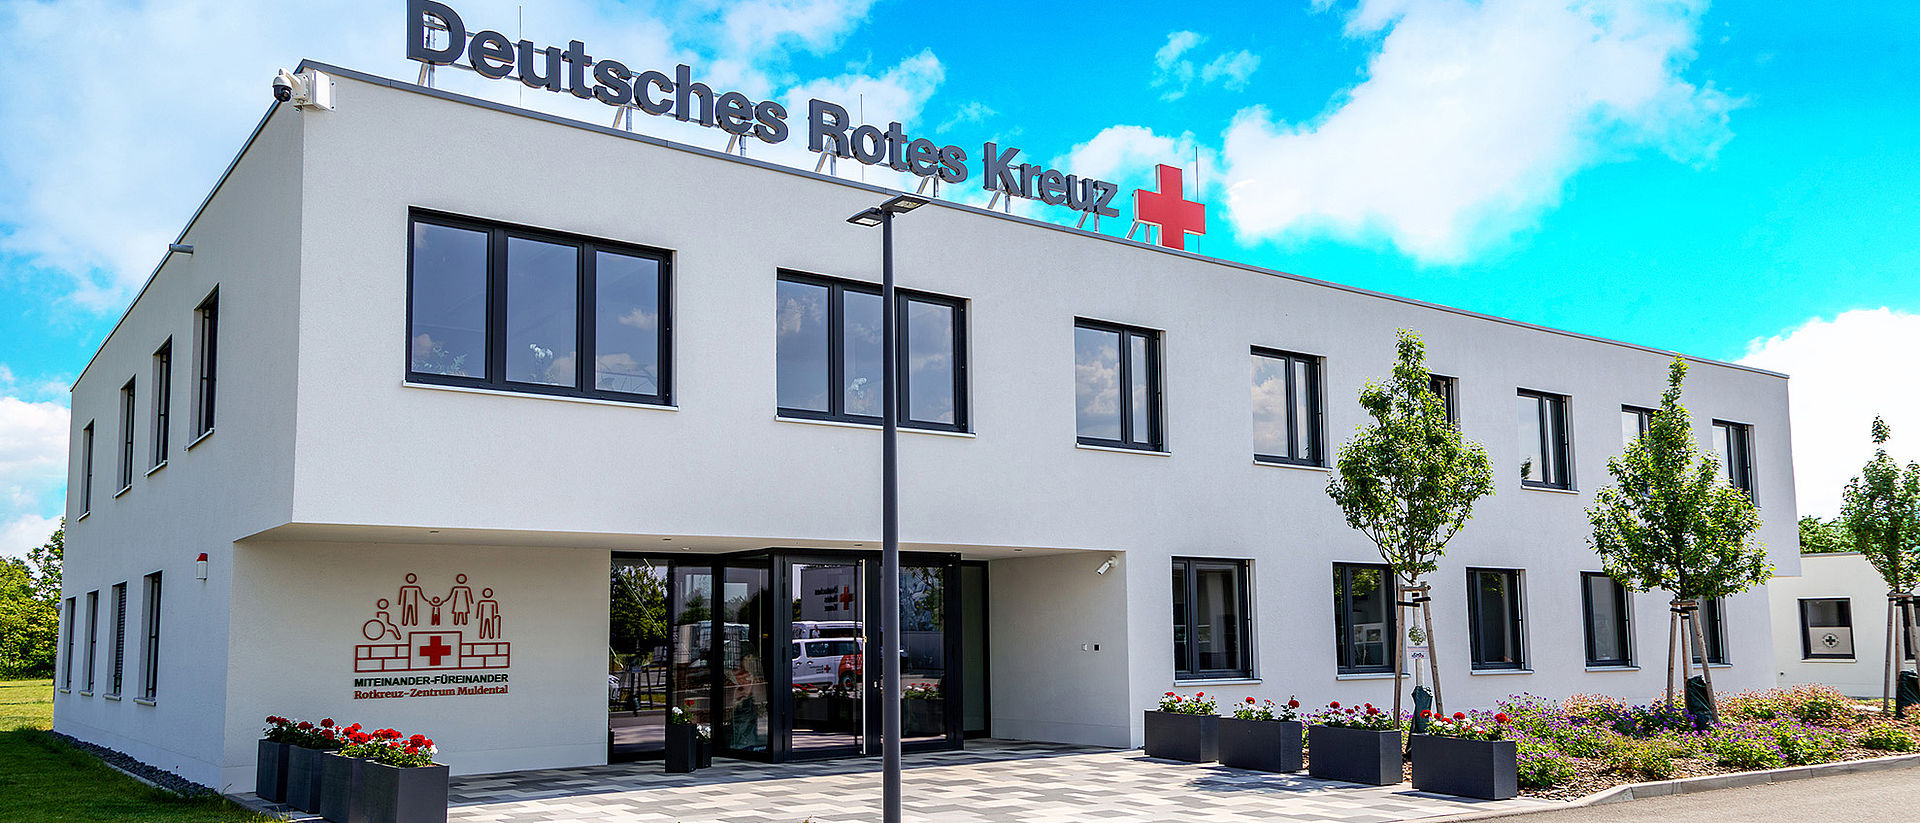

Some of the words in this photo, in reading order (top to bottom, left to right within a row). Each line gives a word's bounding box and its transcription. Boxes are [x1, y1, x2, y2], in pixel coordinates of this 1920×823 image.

[406, 0, 789, 144] Deutsches
[808, 98, 968, 184] Rotes
[983, 142, 1119, 218] Kreuz
[354, 674, 509, 687] MITEINANDER-FÜREINANDER
[457, 685, 509, 697] Muldental
